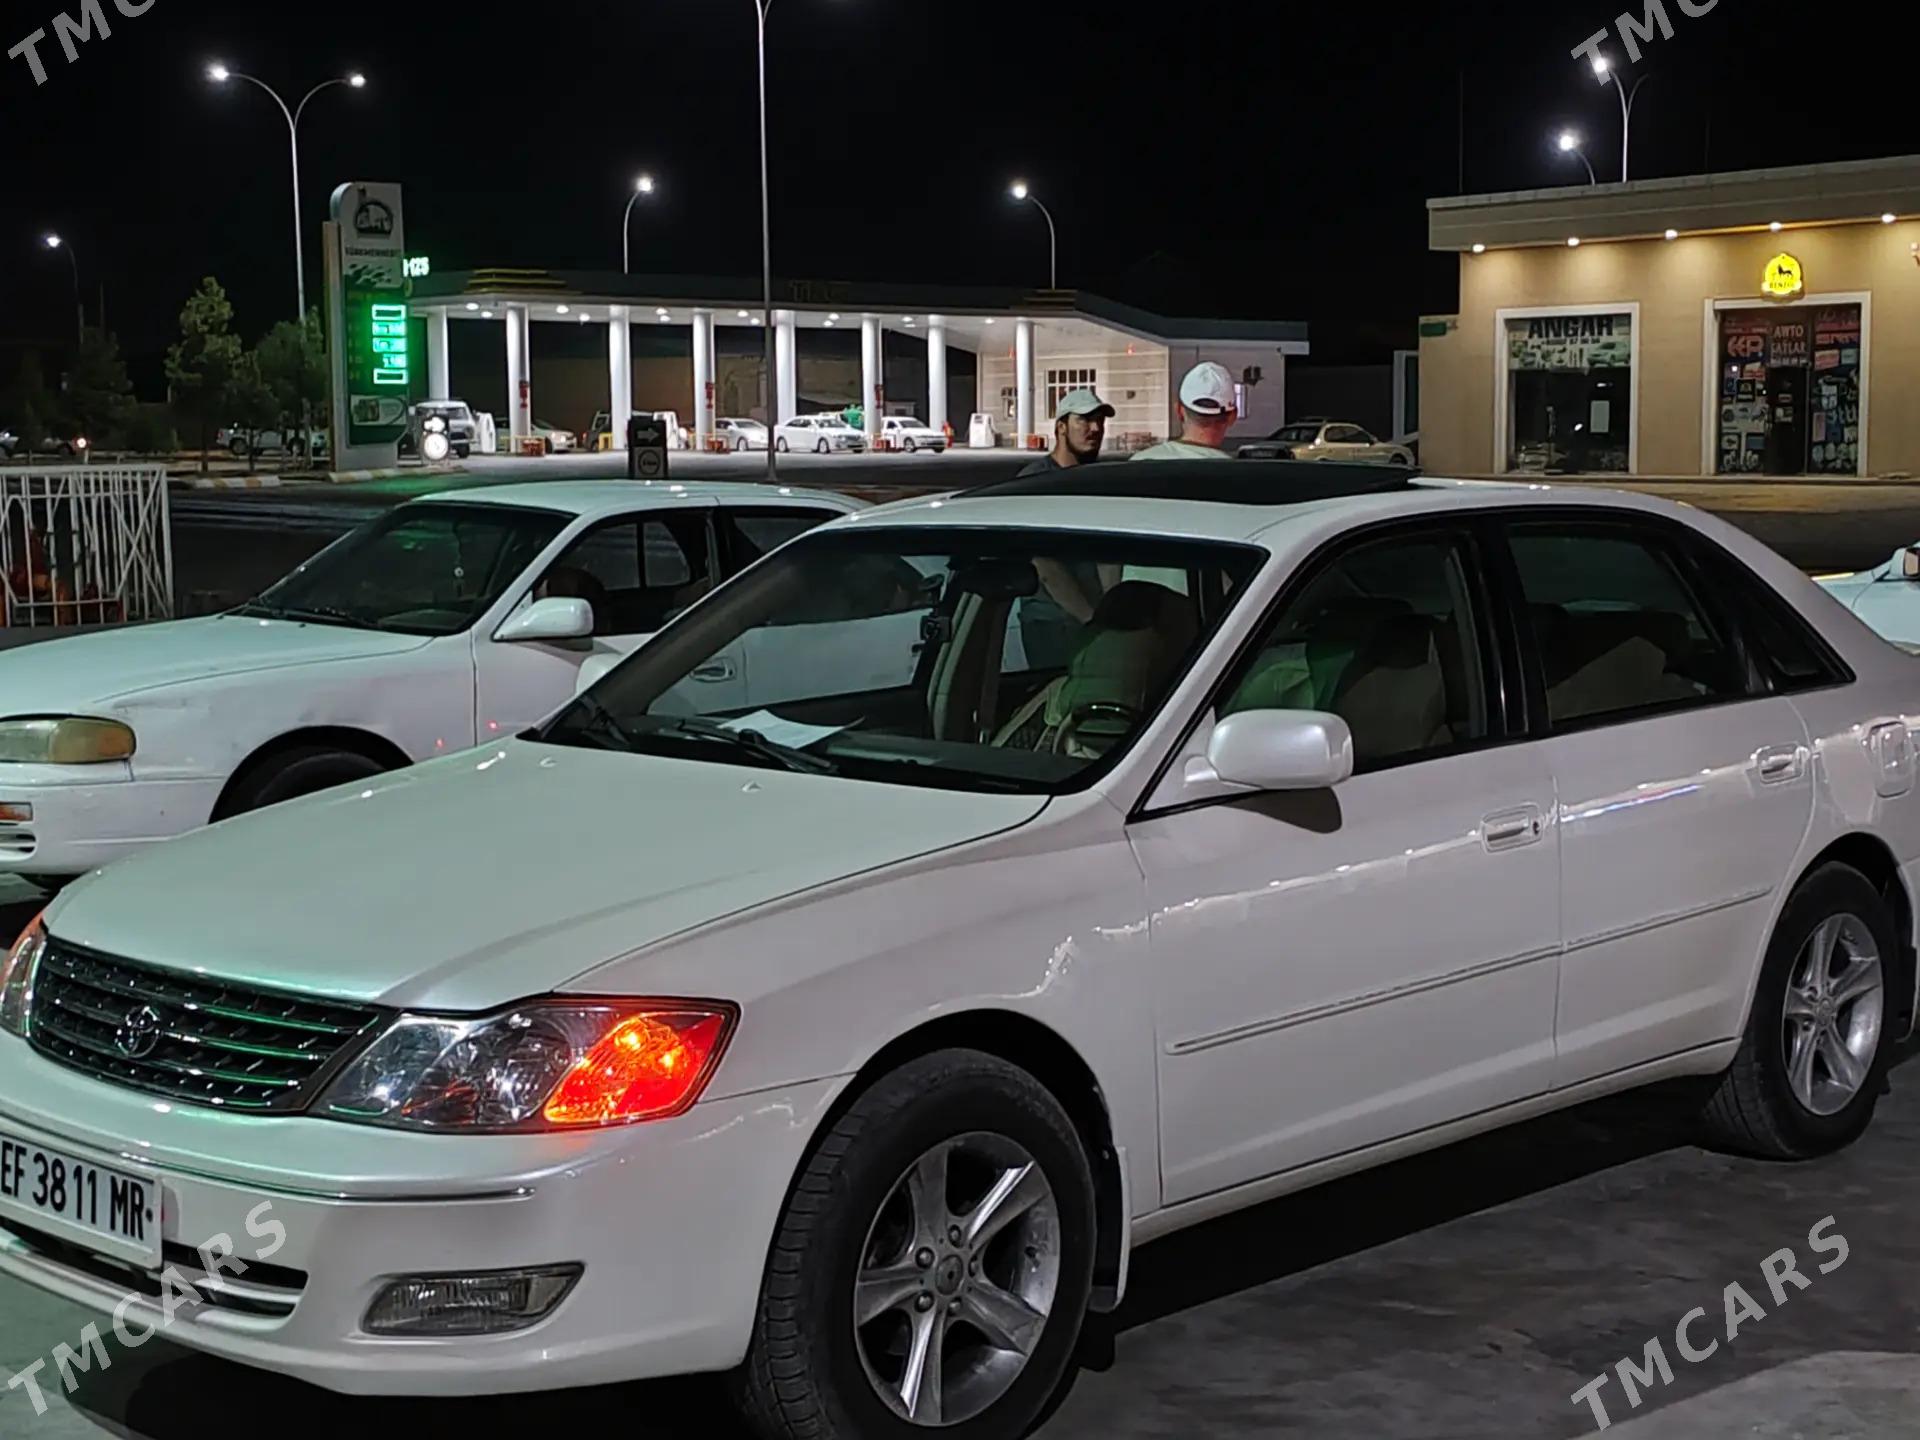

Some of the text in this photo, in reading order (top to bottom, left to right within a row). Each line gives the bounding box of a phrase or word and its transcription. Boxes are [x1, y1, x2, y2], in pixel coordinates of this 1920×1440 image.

[1, 1141, 144, 1240] EF 3811 MR
